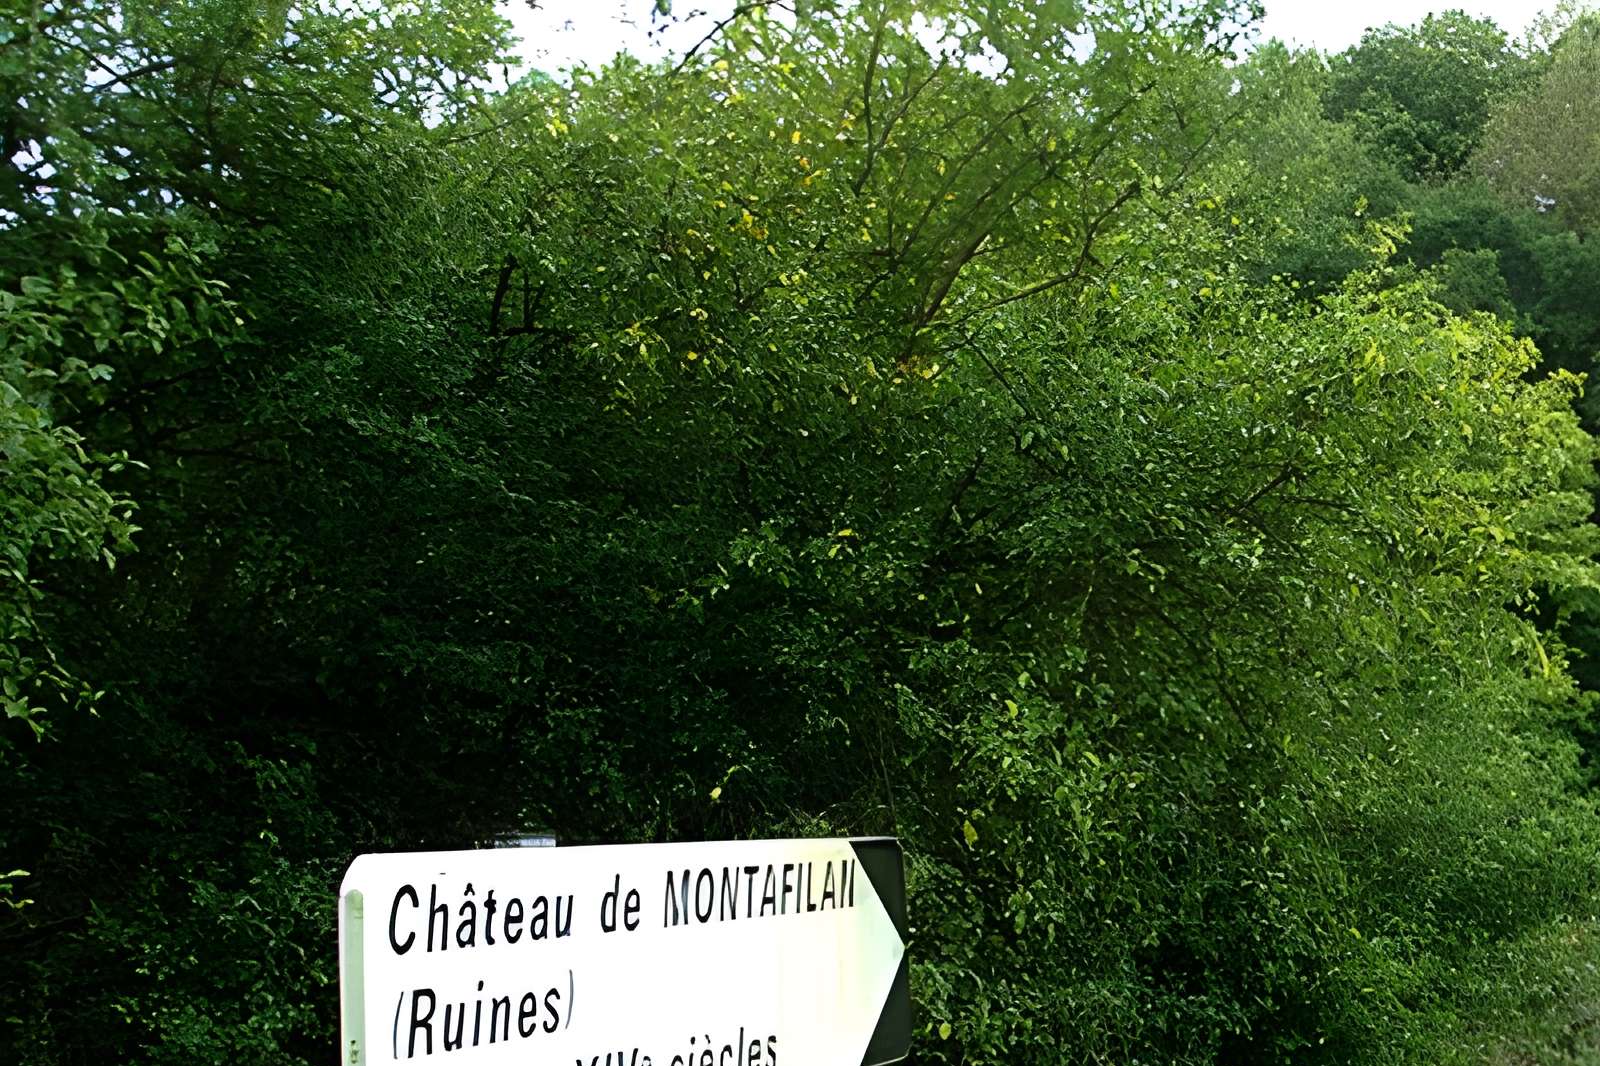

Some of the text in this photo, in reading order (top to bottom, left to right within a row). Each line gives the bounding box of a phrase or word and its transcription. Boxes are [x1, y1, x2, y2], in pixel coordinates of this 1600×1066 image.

[388, 858, 856, 956] Château de MONTAFILAN
[392, 969, 574, 1060] (Ruines)
